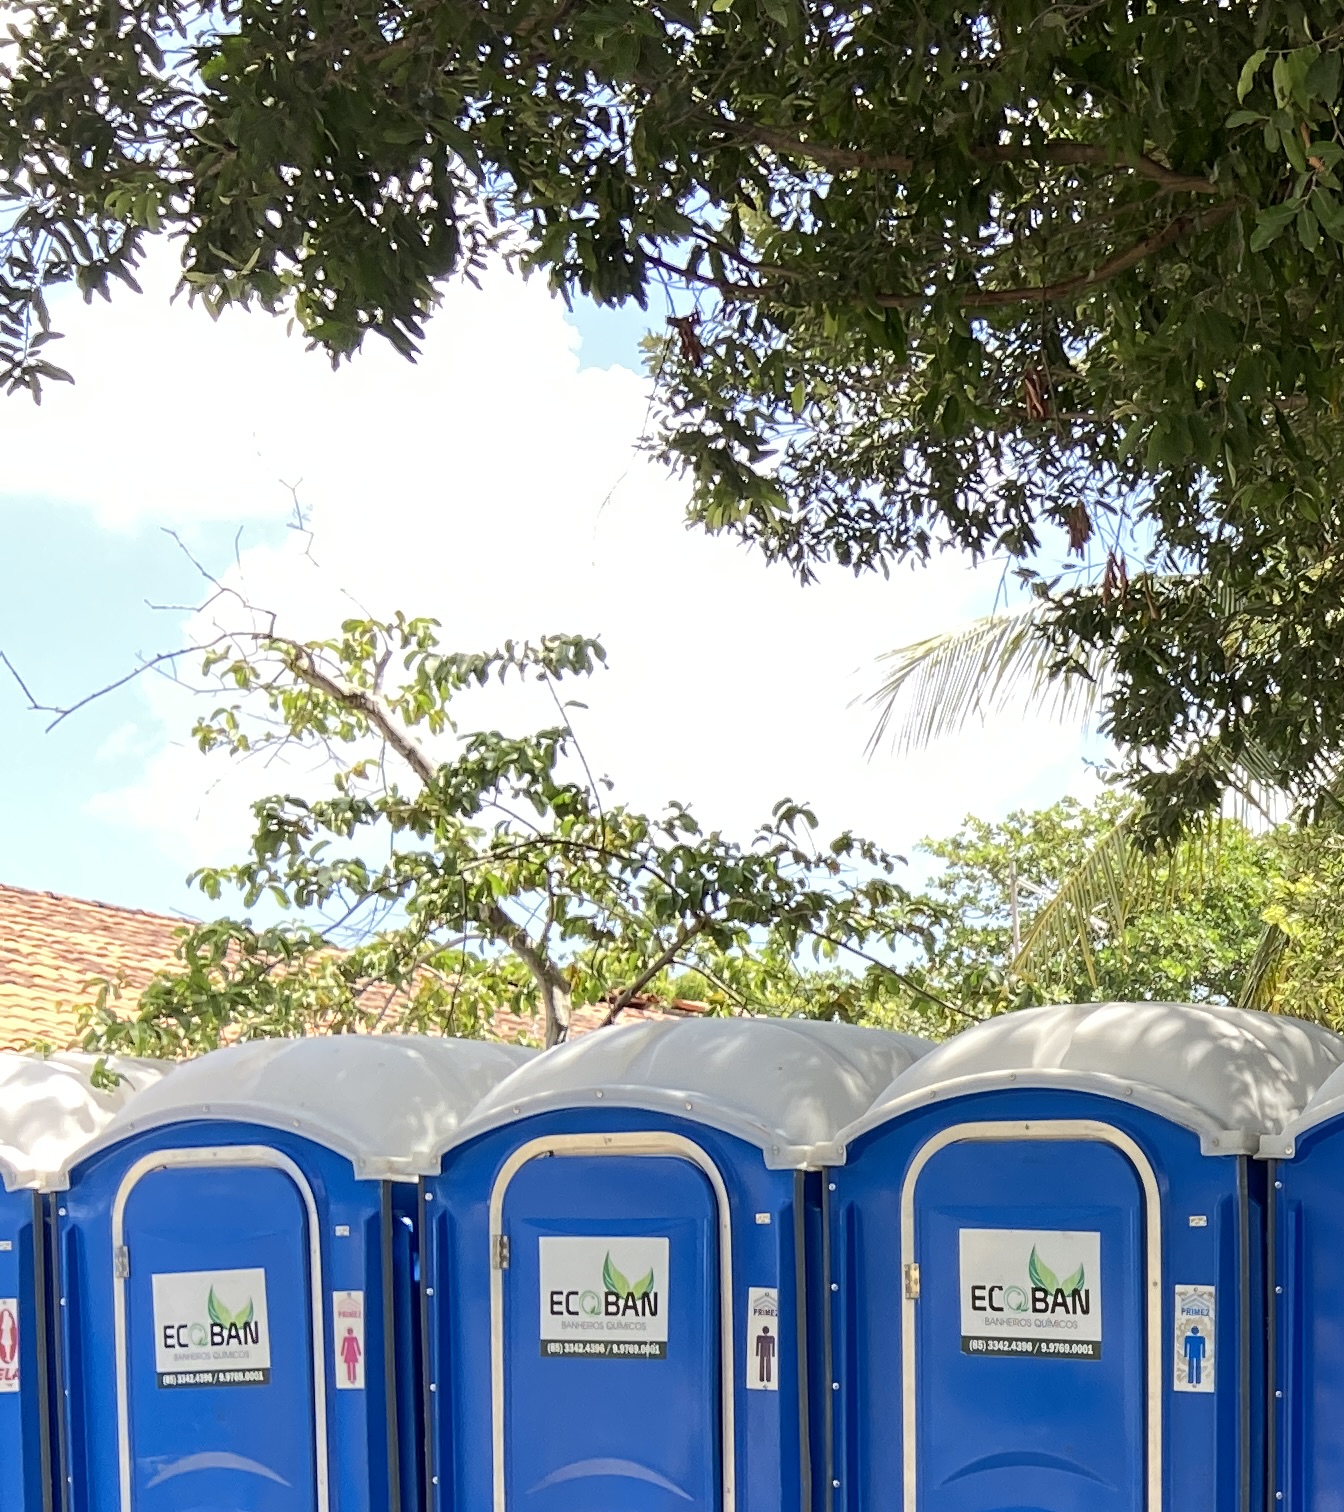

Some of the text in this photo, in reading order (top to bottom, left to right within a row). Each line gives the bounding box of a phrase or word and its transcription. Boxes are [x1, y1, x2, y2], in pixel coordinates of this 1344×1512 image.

[550, 1290, 658, 1317] ECOBAN
[970, 1284, 1090, 1315] ECOBAN
[1181, 1307, 1210, 1317] PRIME2
[561, 1320, 604, 1331] BANHEIROS
[984, 1316, 1078, 1330] BANHEIROS QUÍMICOS
[163, 1321, 259, 1348] ECOBAN
